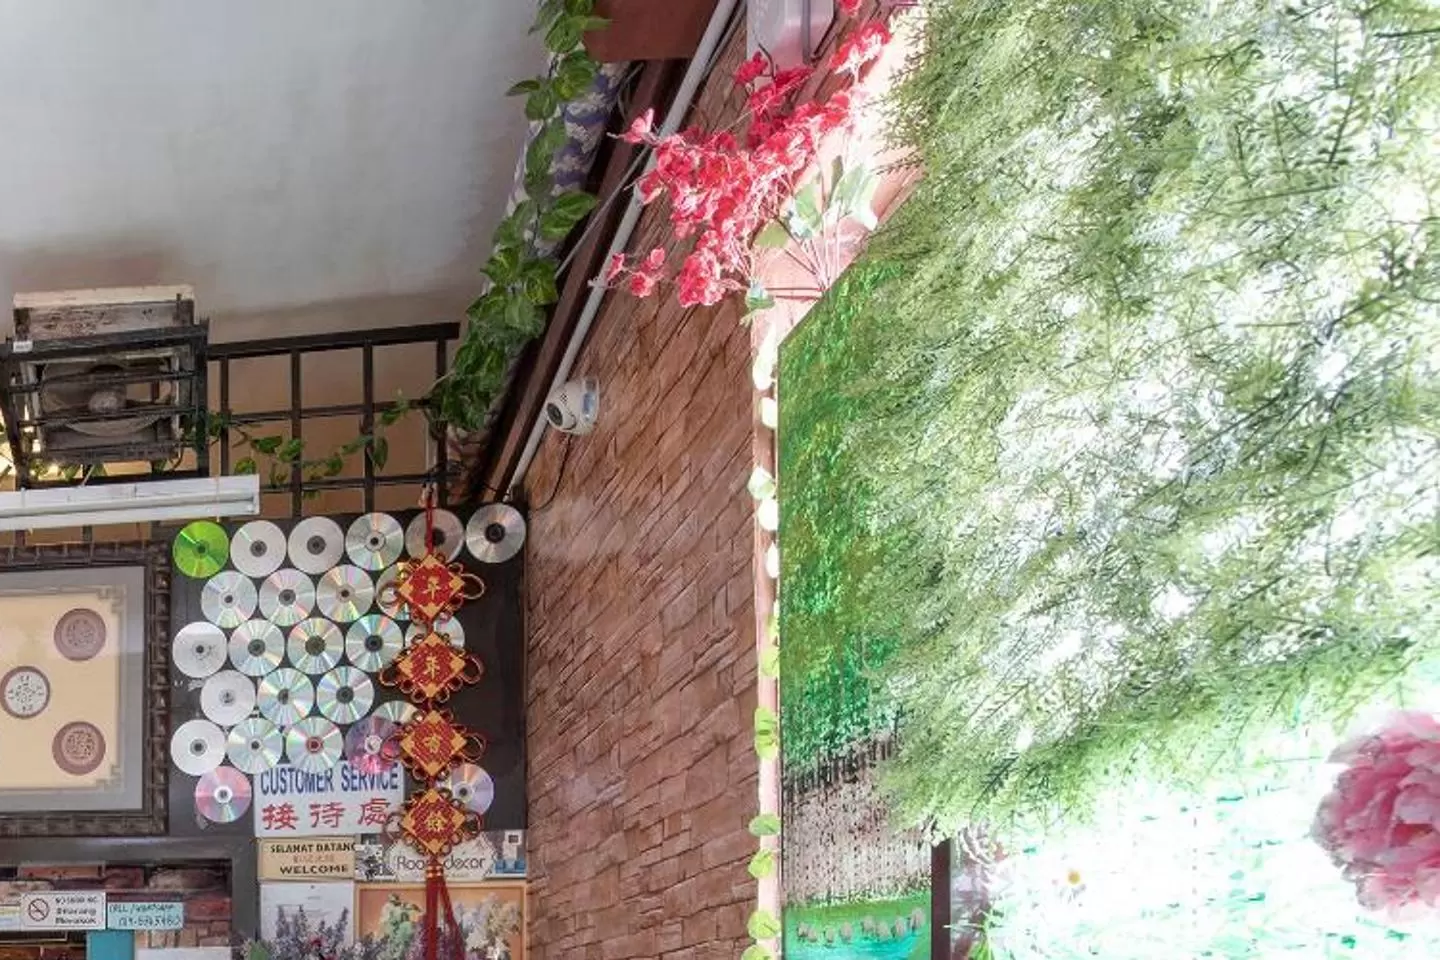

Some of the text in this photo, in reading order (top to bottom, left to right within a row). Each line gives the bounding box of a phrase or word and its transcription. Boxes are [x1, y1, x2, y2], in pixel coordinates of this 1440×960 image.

[260, 762, 399, 796] CUSTOMER SERVICE
[271, 844, 313, 854] SELAMAT
[396, 855, 486, 870] Roo decor
[279, 865, 349, 875] WELCOME
